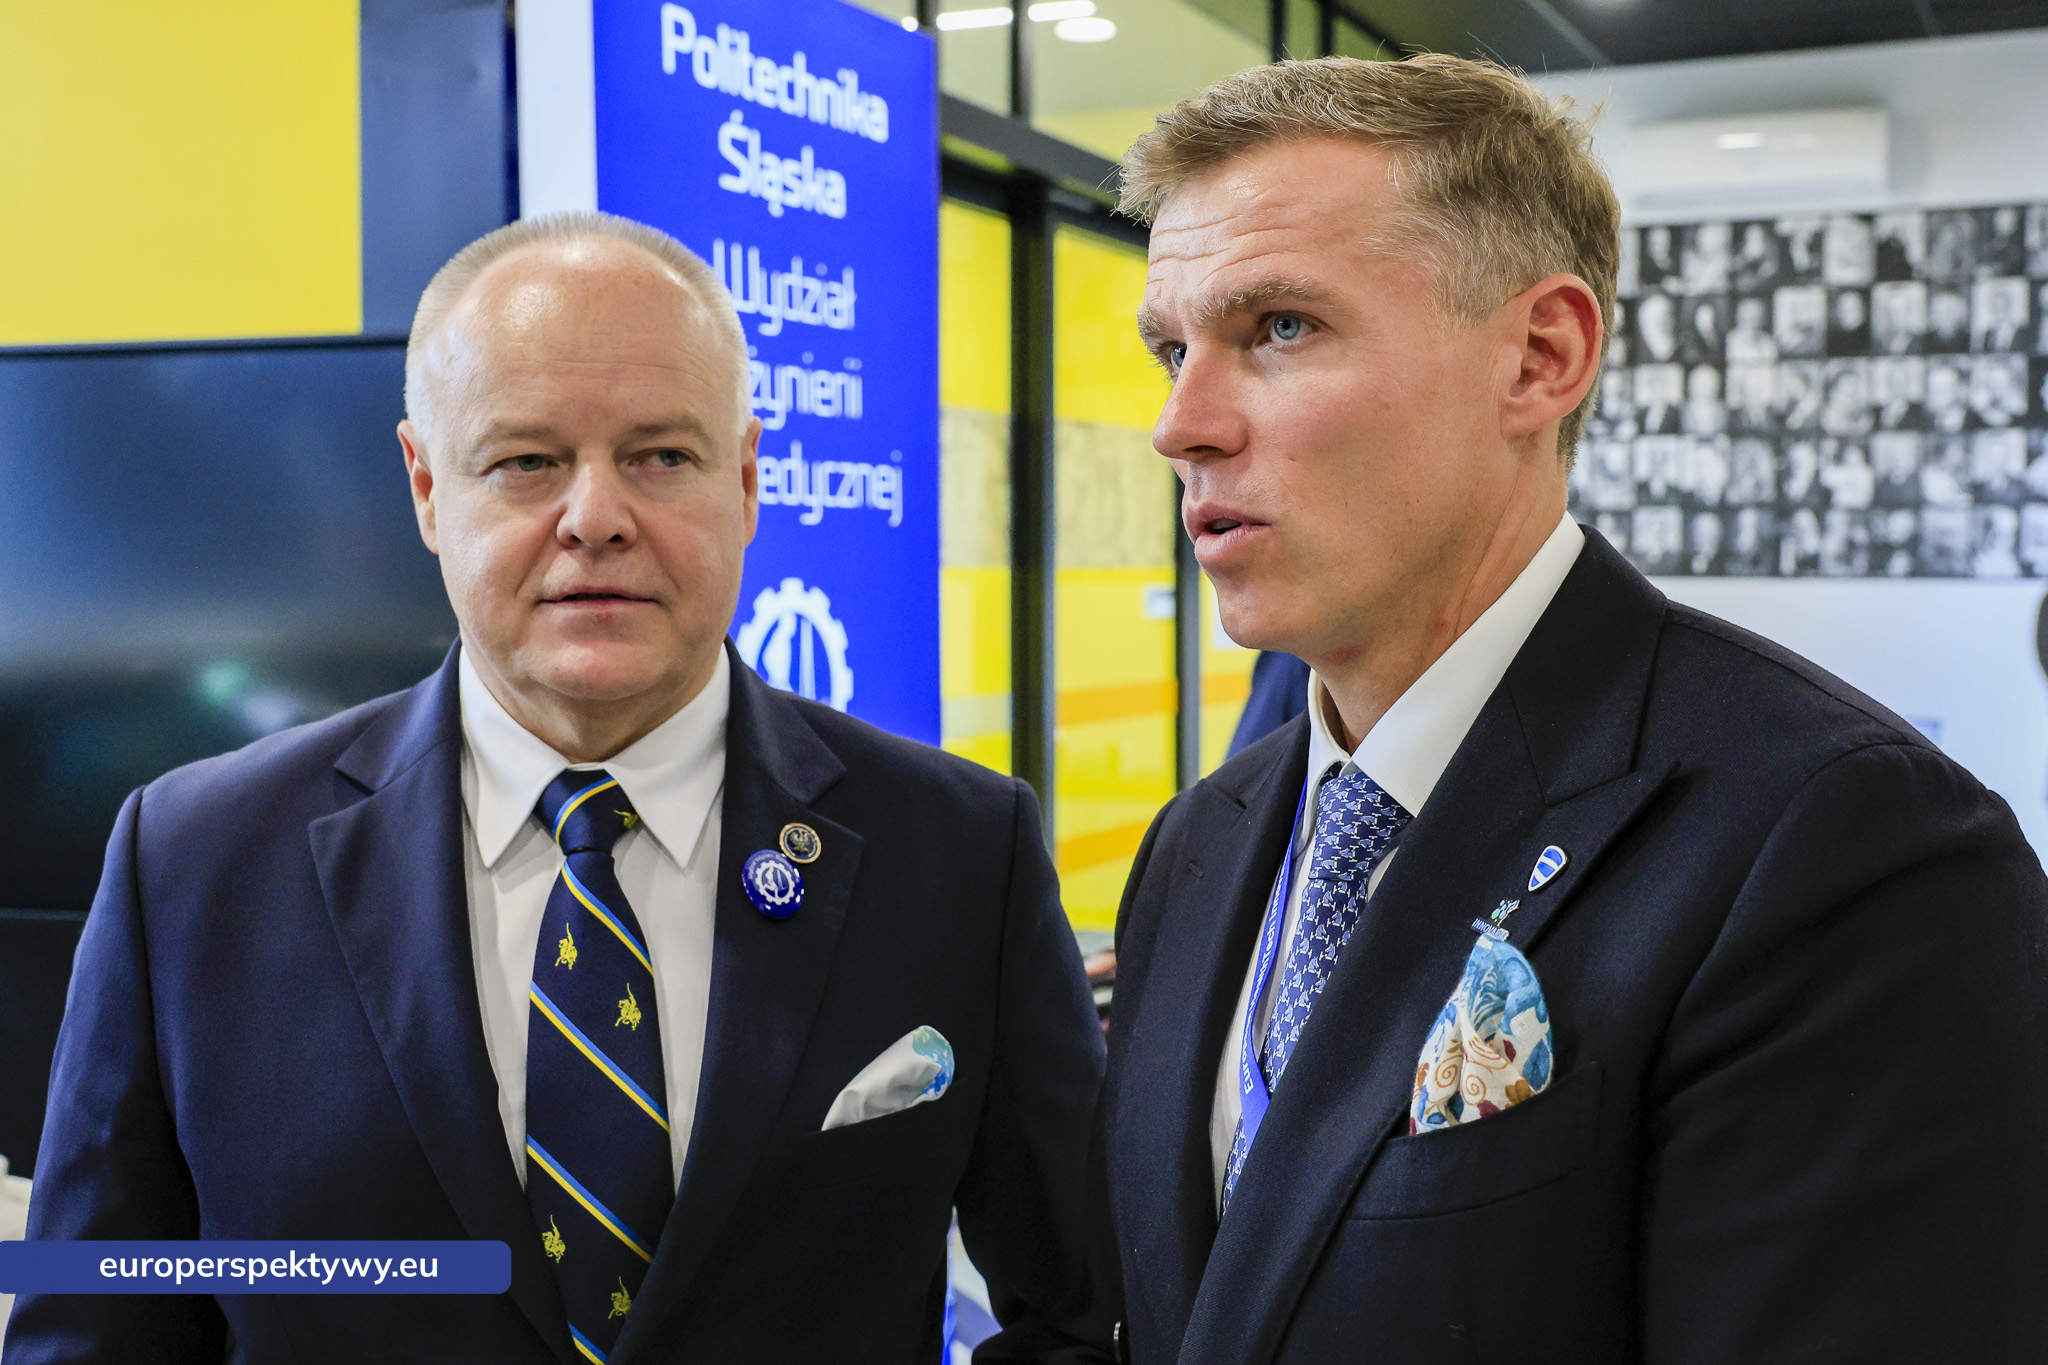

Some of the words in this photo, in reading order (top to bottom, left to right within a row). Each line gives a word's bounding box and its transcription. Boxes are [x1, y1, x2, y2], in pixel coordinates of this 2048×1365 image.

[660, 2, 890, 143] Politechnika
[717, 109, 847, 219] Śląska
[712, 238, 857, 337] Wydział
[748, 345, 863, 431] żynierii
[756, 439, 903, 528] edycznej
